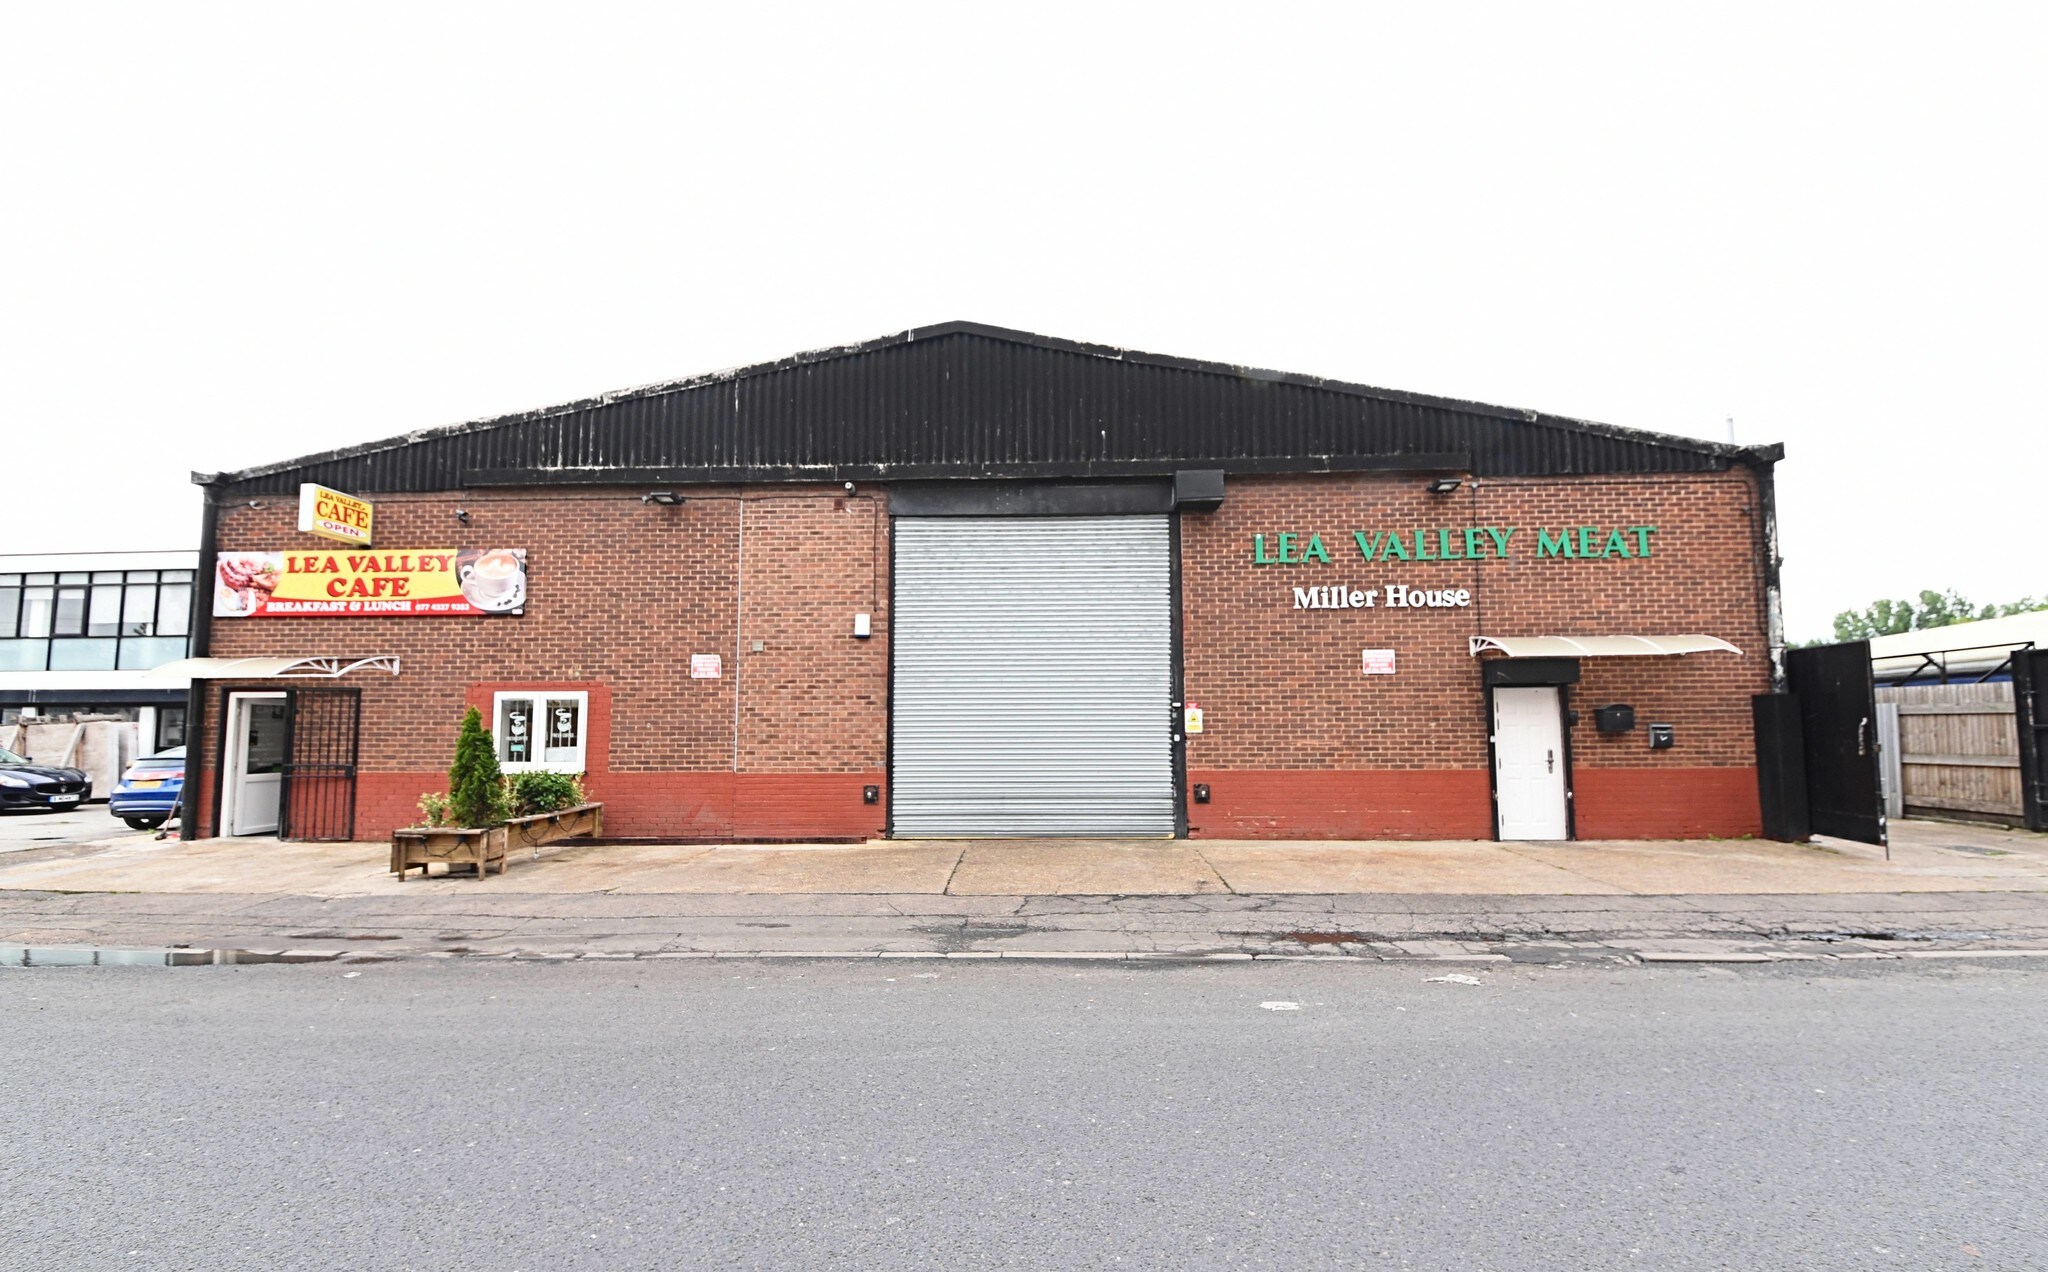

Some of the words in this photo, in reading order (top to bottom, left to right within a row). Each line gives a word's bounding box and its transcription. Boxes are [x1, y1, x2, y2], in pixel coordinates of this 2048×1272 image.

[320, 491, 334, 501] LEA
[323, 521, 359, 536] OPEN
[1253, 532, 1331, 564] LEA
[1354, 527, 1515, 562] VALLEY
[1536, 525, 1658, 559] MEAT
[287, 556, 340, 573] LEA
[347, 554, 454, 573] VALLEY
[326, 576, 410, 597] CAFE
[266, 601, 347, 613] BREAKFAST
[349, 602, 361, 612] &
[363, 601, 411, 612] LUNCH
[1293, 586, 1378, 610] Miller
[1385, 585, 1471, 609] House
